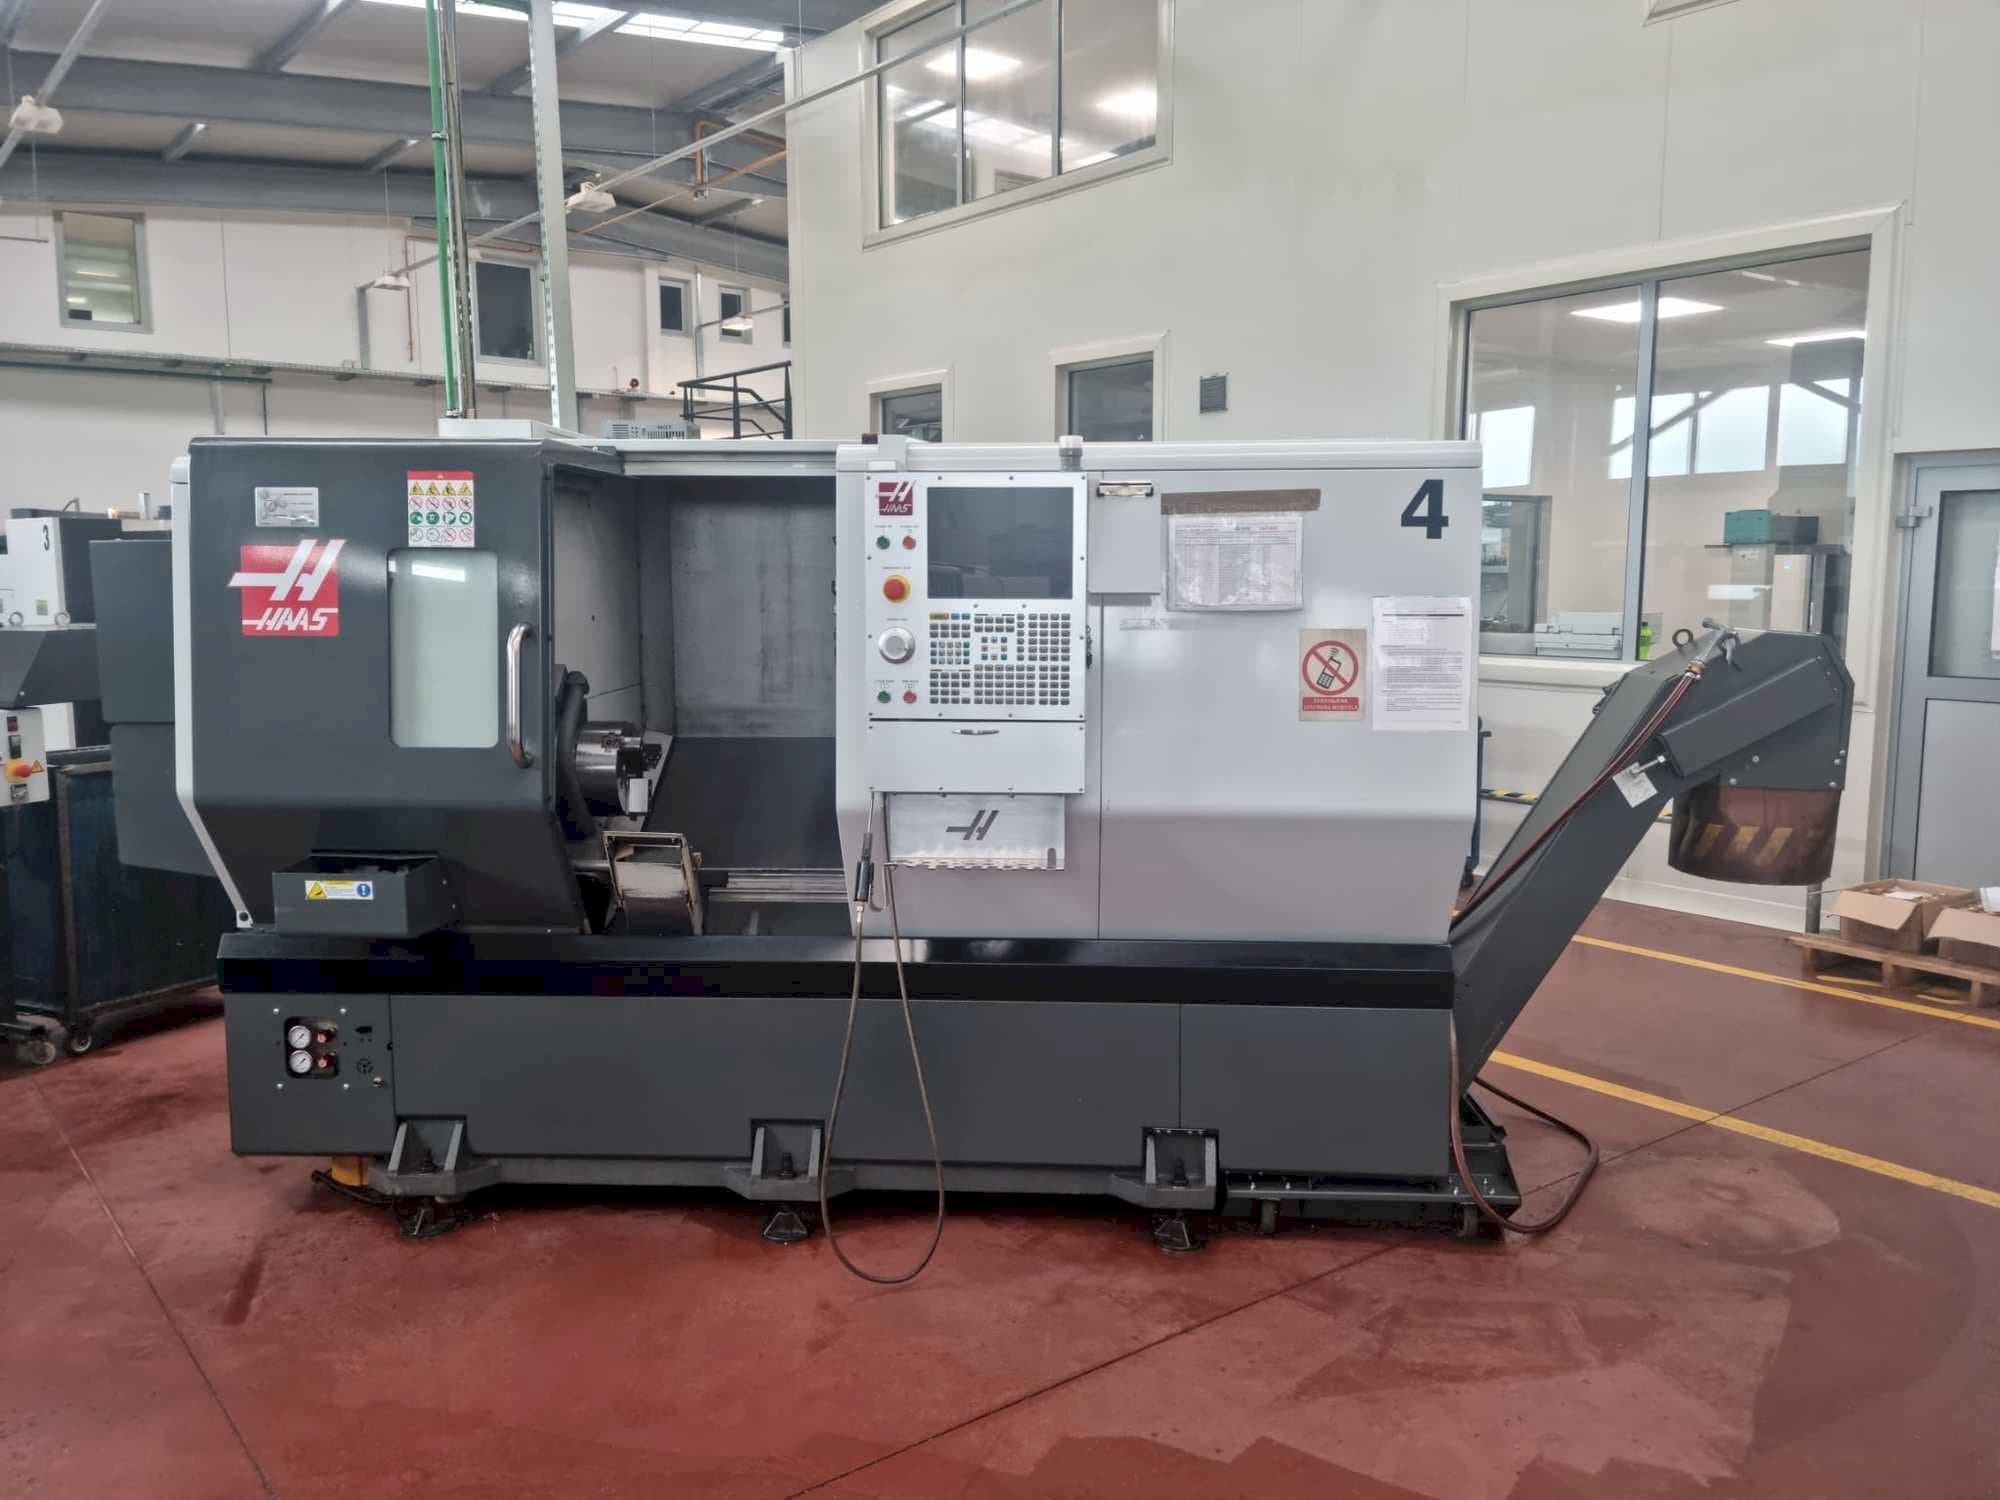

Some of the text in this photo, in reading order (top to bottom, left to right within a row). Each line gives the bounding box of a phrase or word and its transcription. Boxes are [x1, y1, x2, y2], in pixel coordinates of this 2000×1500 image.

[1401, 479, 1448, 539] 4
[43, 525, 50, 551] 3
[242, 607, 338, 631] HAAS
